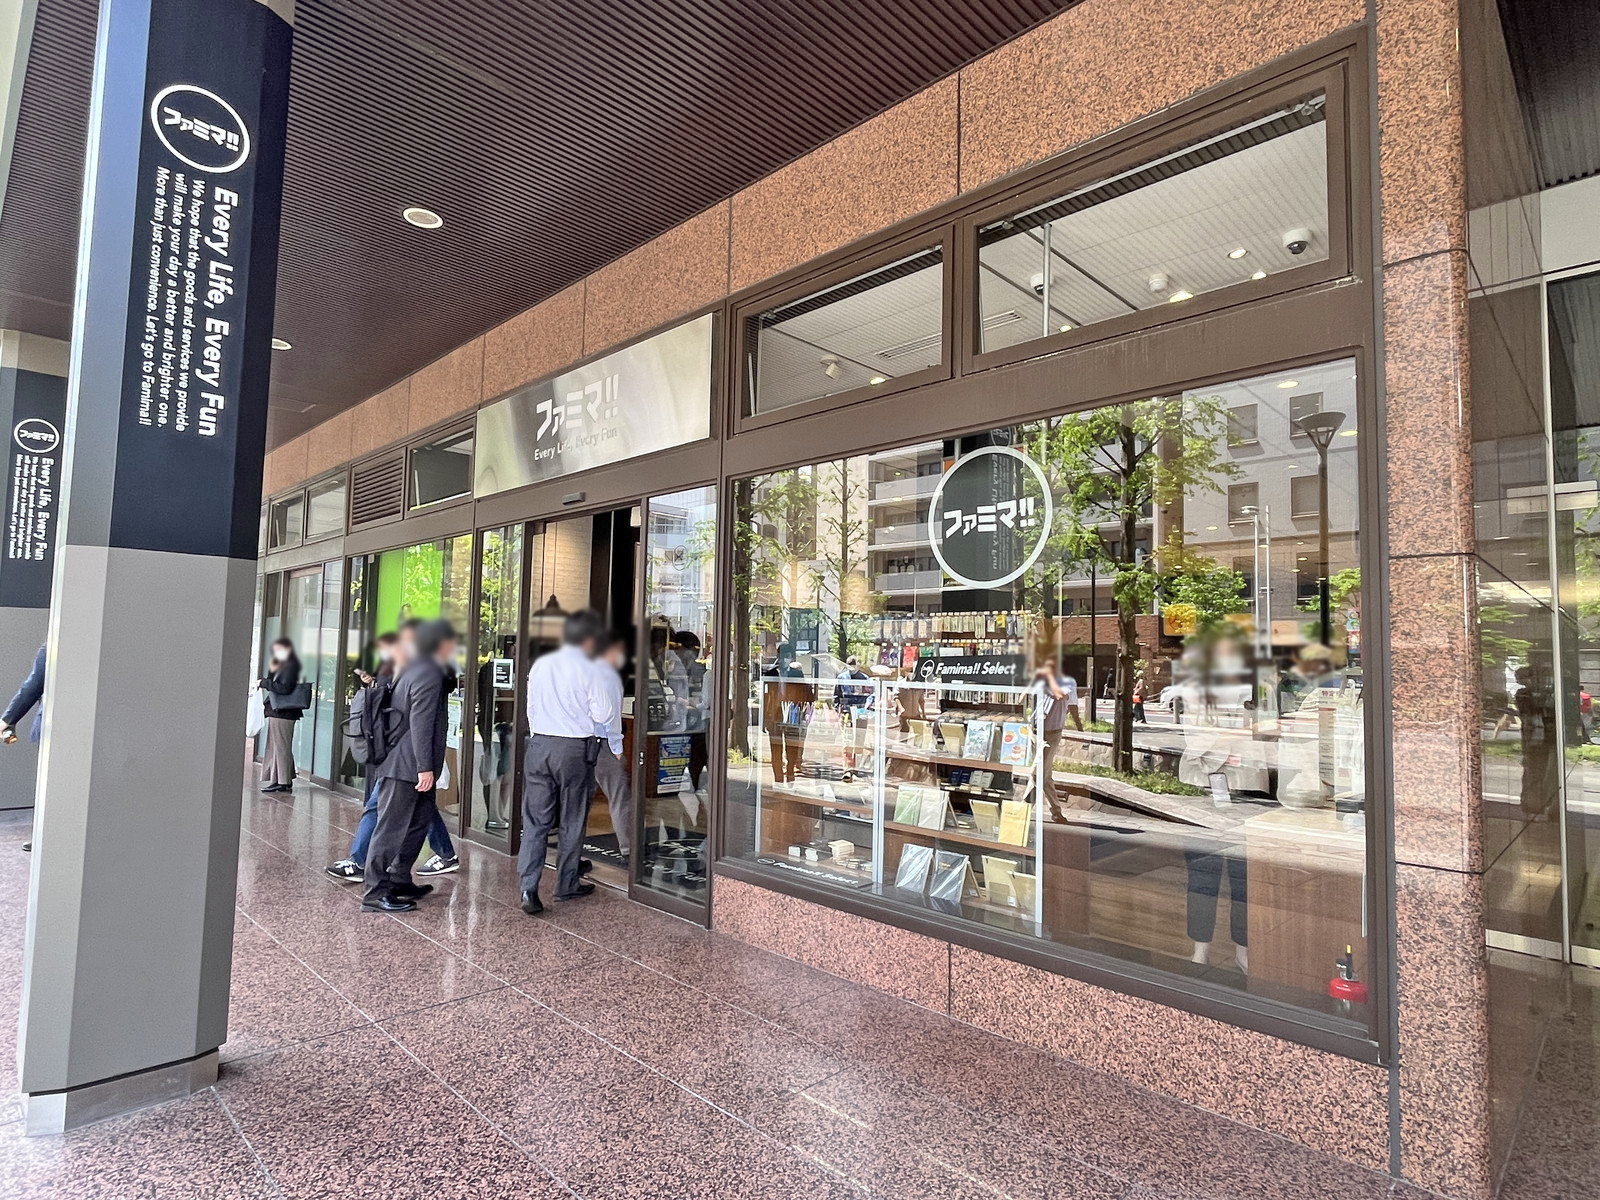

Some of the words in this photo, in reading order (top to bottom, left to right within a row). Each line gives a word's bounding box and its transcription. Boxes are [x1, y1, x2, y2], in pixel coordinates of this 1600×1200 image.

[156, 166, 170, 195] More
[174, 174, 188, 194] will
[192, 180, 205, 197] We
[154, 198, 168, 222] than
[172, 195, 186, 225] make
[188, 198, 204, 226] hope
[204, 187, 238, 256] Every
[150, 220, 166, 243] just
[168, 226, 181, 254] your
[188, 228, 202, 250] that
[165, 256, 182, 278] day
[187, 252, 200, 269] the
[147, 244, 162, 312] convenience.
[168, 279, 177, 287] a
[184, 270, 198, 304] goods
[204, 260, 234, 309] Life,
[165, 289, 180, 326] better
[183, 306, 196, 328] and
[145, 315, 159, 342] Let's
[163, 328, 176, 351] and
[141, 342, 154, 358] go
[180, 328, 193, 370] services
[195, 318, 230, 388] Every
[143, 361, 154, 373] to
[158, 352, 176, 400] brighter
[179, 372, 188, 388] we
[158, 402, 168, 427] one.
[175, 390, 189, 431] provide
[198, 392, 224, 436] Fun
[536, 374, 619, 442] ファミマ!!
[534, 446, 555, 460] Every
[575, 433, 600, 449] Every
[601, 427, 618, 441] Fun
[38, 458, 54, 487] Every
[37, 488, 52, 508] Life,
[33, 511, 50, 540] Every
[944, 496, 1034, 539] ファミマ!!
[34, 542, 48, 560] Fun
[982, 661, 1016, 674] Select
